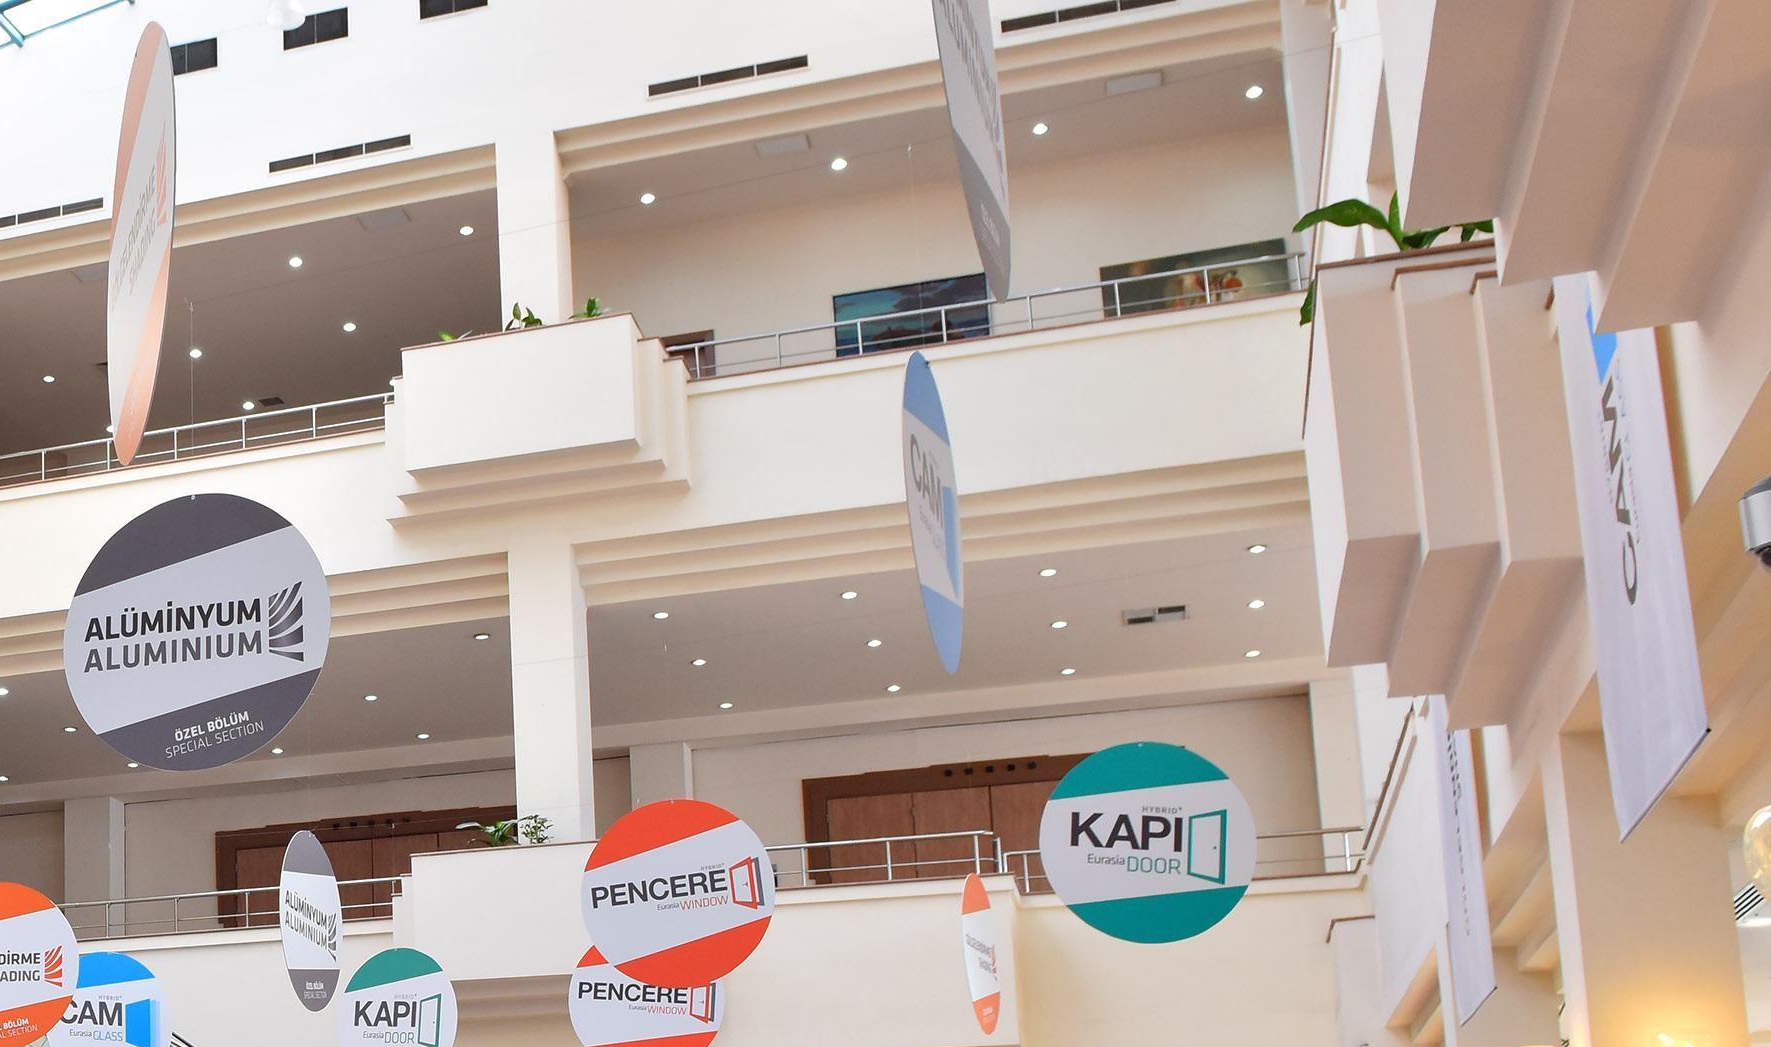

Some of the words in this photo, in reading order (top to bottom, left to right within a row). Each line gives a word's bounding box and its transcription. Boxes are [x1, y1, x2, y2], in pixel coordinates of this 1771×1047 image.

[84, 598, 262, 643] ALÜMİNYUM
[83, 630, 263, 674] ALUMINIUM
[165, 738, 212, 759] SPECIAL
[214, 720, 264, 745] SECTION
[174, 725, 205, 742] ÖZEL
[207, 711, 249, 732] BÖLÜM
[1070, 811, 1183, 853] KAPI
[1087, 853, 1125, 866] Eurasia
[1127, 856, 1181, 874] DOOR
[590, 869, 728, 909] PENCERE
[285, 889, 328, 929] ALÜMİNYUM
[657, 902, 679, 911] Eurasia
[679, 895, 728, 912] WINDOW
[285, 910, 328, 950] ALUMINIUM
[578, 981, 688, 1004] PENCERE
[3, 1018, 29, 1030] BÖLÜM
[61, 1000, 123, 1027] CAM
[354, 1000, 417, 1028] KAPI
[647, 1005, 687, 1016] WINDOW
[8, 1025, 38, 1038] SECTION
[69, 1029, 93, 1039] Eurasia
[93, 1031, 123, 1042] GLASS
[363, 1030, 384, 1040] Eurasia
[384, 1032, 415, 1044] DOOR
